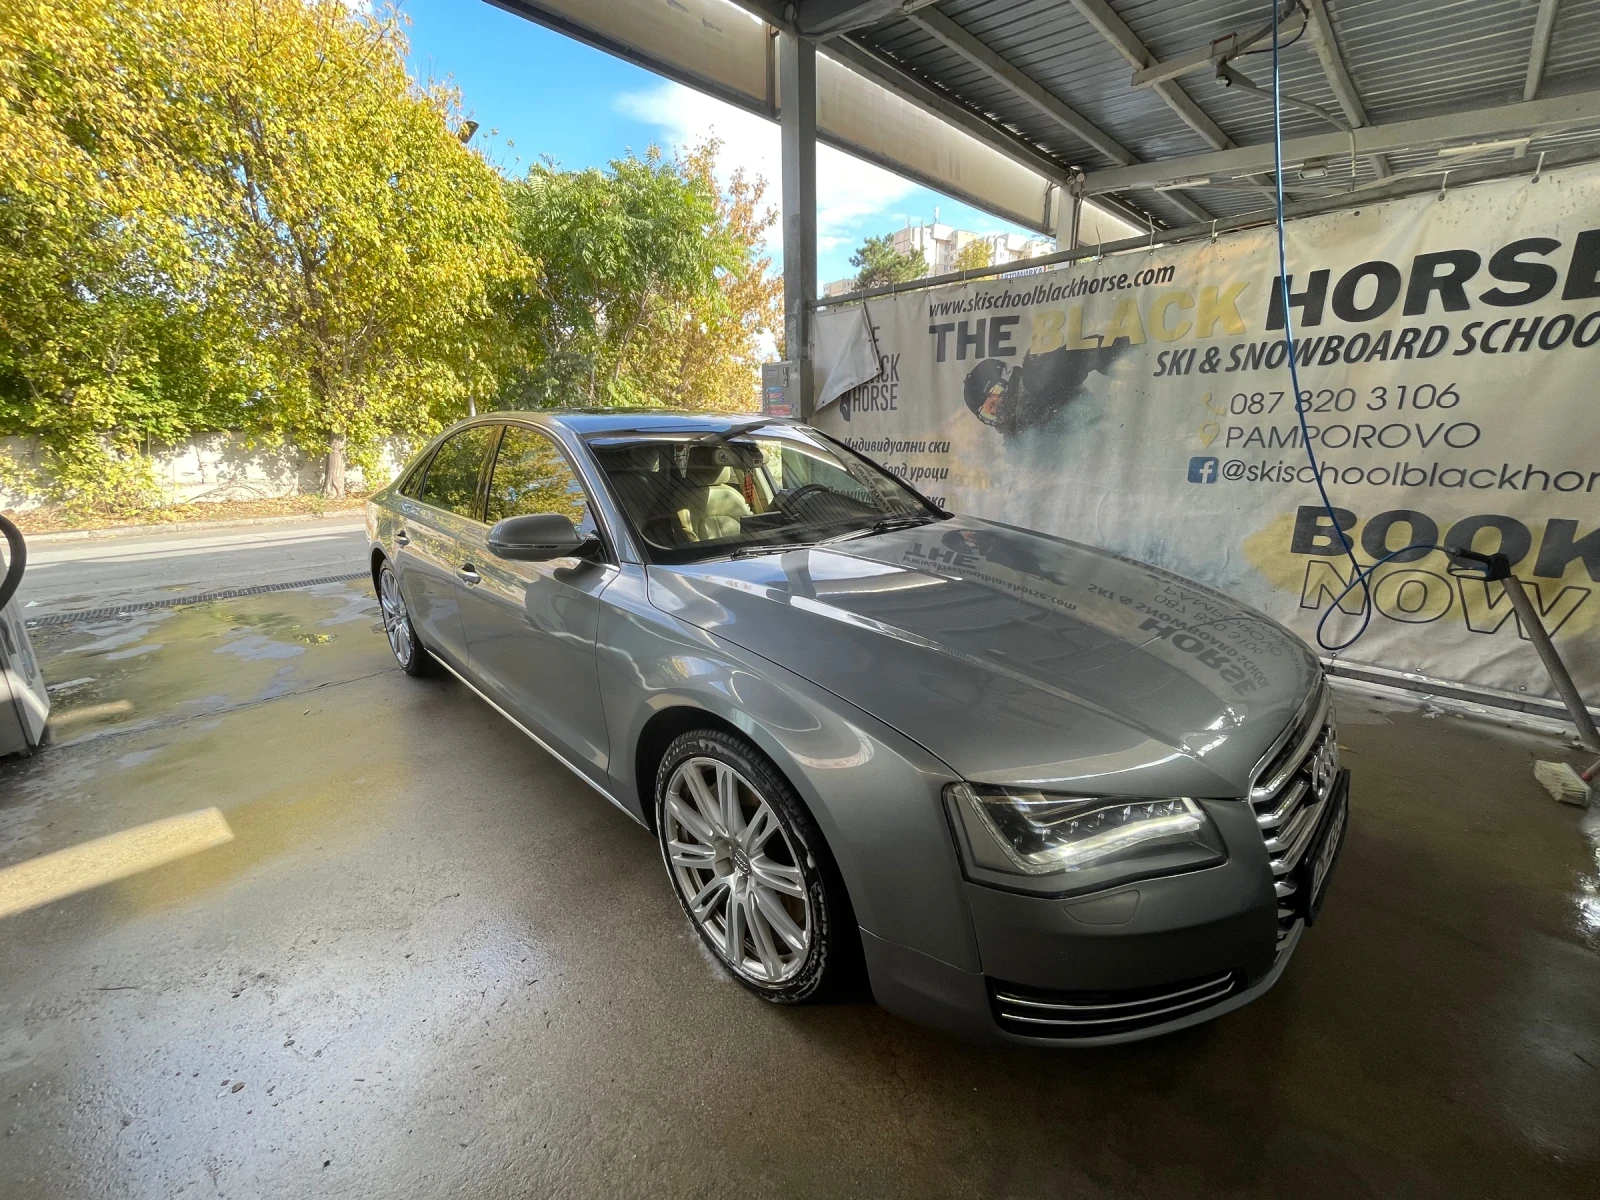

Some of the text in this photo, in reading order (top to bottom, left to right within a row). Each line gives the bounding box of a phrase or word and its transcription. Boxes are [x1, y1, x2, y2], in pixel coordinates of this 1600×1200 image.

[929, 265, 1176, 318] www.skischoolblackhorse.com
[929, 315, 1020, 362] THE
[1030, 281, 1250, 355] BLACK
[1153, 348, 1196, 377] SKI
[1198, 346, 1221, 374] &
[1225, 325, 1450, 372] SNOWBOARD
[853, 383, 899, 412] HORSE
[1230, 382, 1460, 415] 087 820 3106
[844, 437, 951, 456] Индивидуални ски
[1225, 422, 1481, 449] PAMPOROVO
[907, 465, 950, 483] уроци
[1290, 505, 1600, 583] BOOK
[1300, 560, 1593, 641] NOW
